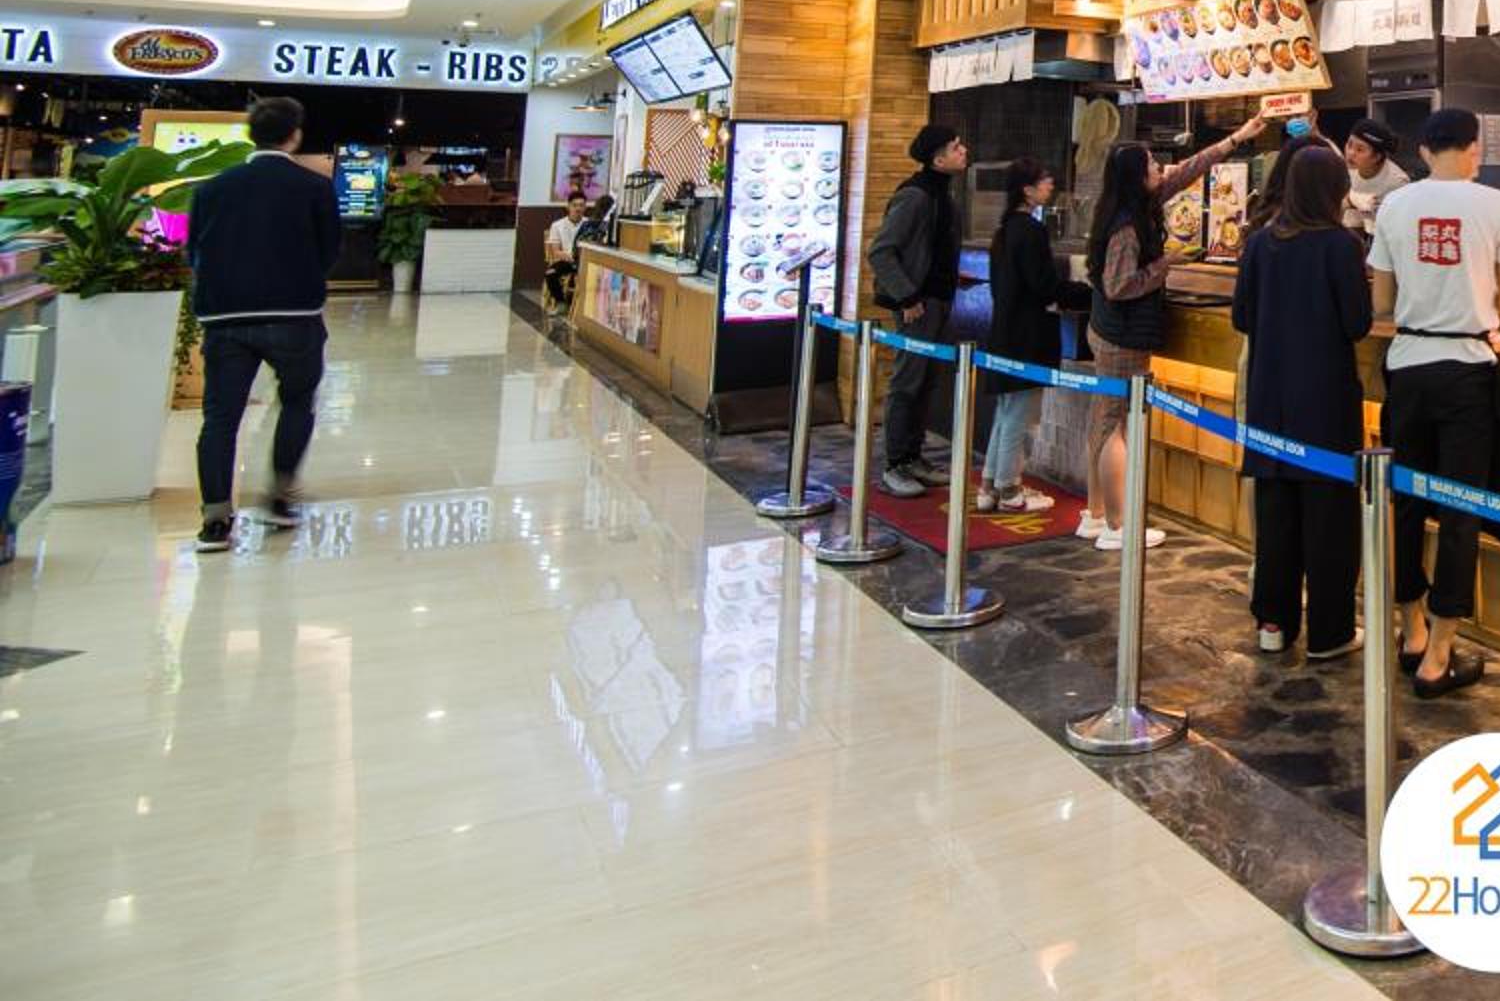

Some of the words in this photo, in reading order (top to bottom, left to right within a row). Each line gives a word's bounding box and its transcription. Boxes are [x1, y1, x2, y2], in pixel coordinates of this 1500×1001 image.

[2, 28, 54, 63] TA
[273, 44, 397, 78] STEAK
[448, 50, 527, 82] RIBS
